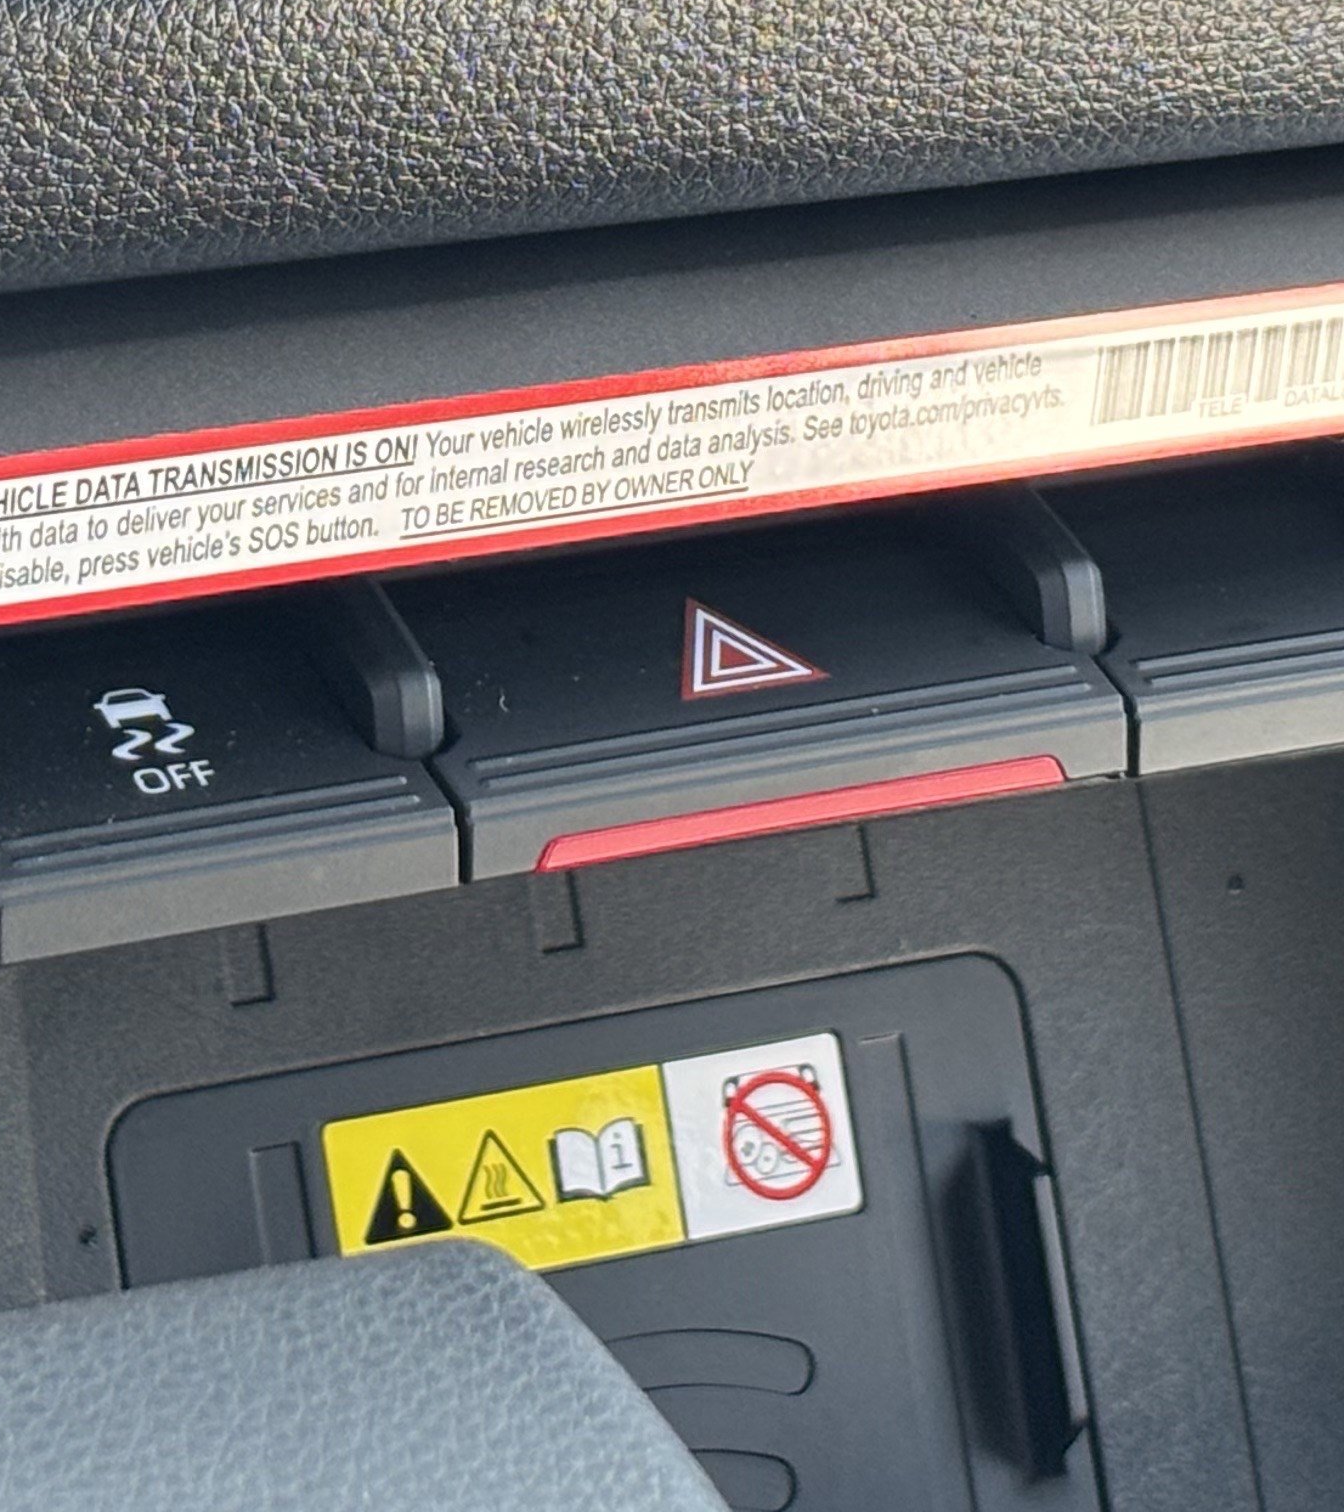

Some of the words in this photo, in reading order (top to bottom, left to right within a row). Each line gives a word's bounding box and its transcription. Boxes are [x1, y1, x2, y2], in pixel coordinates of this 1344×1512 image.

[75, 470, 141, 506] DATA
[148, 442, 339, 496] TRANSMISSION
[345, 440, 368, 469] IS
[375, 433, 419, 465] ON!
[425, 431, 475, 458] Your
[480, 416, 554, 450] vehicle
[560, 401, 663, 440] wirelessly
[667, 389, 761, 426] transmits
[857, 367, 924, 400] driving
[929, 360, 970, 390] and
[975, 350, 1042, 385] vehicle
[1197, 396, 1244, 419] TELE
[29, 520, 79, 550] data
[87, 514, 109, 540] to
[117, 503, 192, 537] deliver
[196, 497, 247, 533] your
[251, 486, 342, 518] services
[348, 473, 389, 505] and
[395, 471, 425, 500] for
[429, 457, 509, 491] internal
[514, 444, 606, 484] research
[611, 434, 651, 469] and
[657, 435, 702, 460] data
[708, 419, 797, 456] analysis.
[803, 415, 844, 442] See
[78, 548, 140, 585] press
[147, 531, 242, 567] vehicle's
[248, 521, 300, 554] SOS
[305, 515, 380, 546] button.
[401, 505, 431, 532] TO
[435, 499, 465, 526] BE
[469, 484, 577, 522] REMOVED
[581, 479, 612, 506] BY
[613, 468, 695, 502] OWNER
[698, 459, 755, 489] ONLY
[133, 759, 216, 794] OFF
